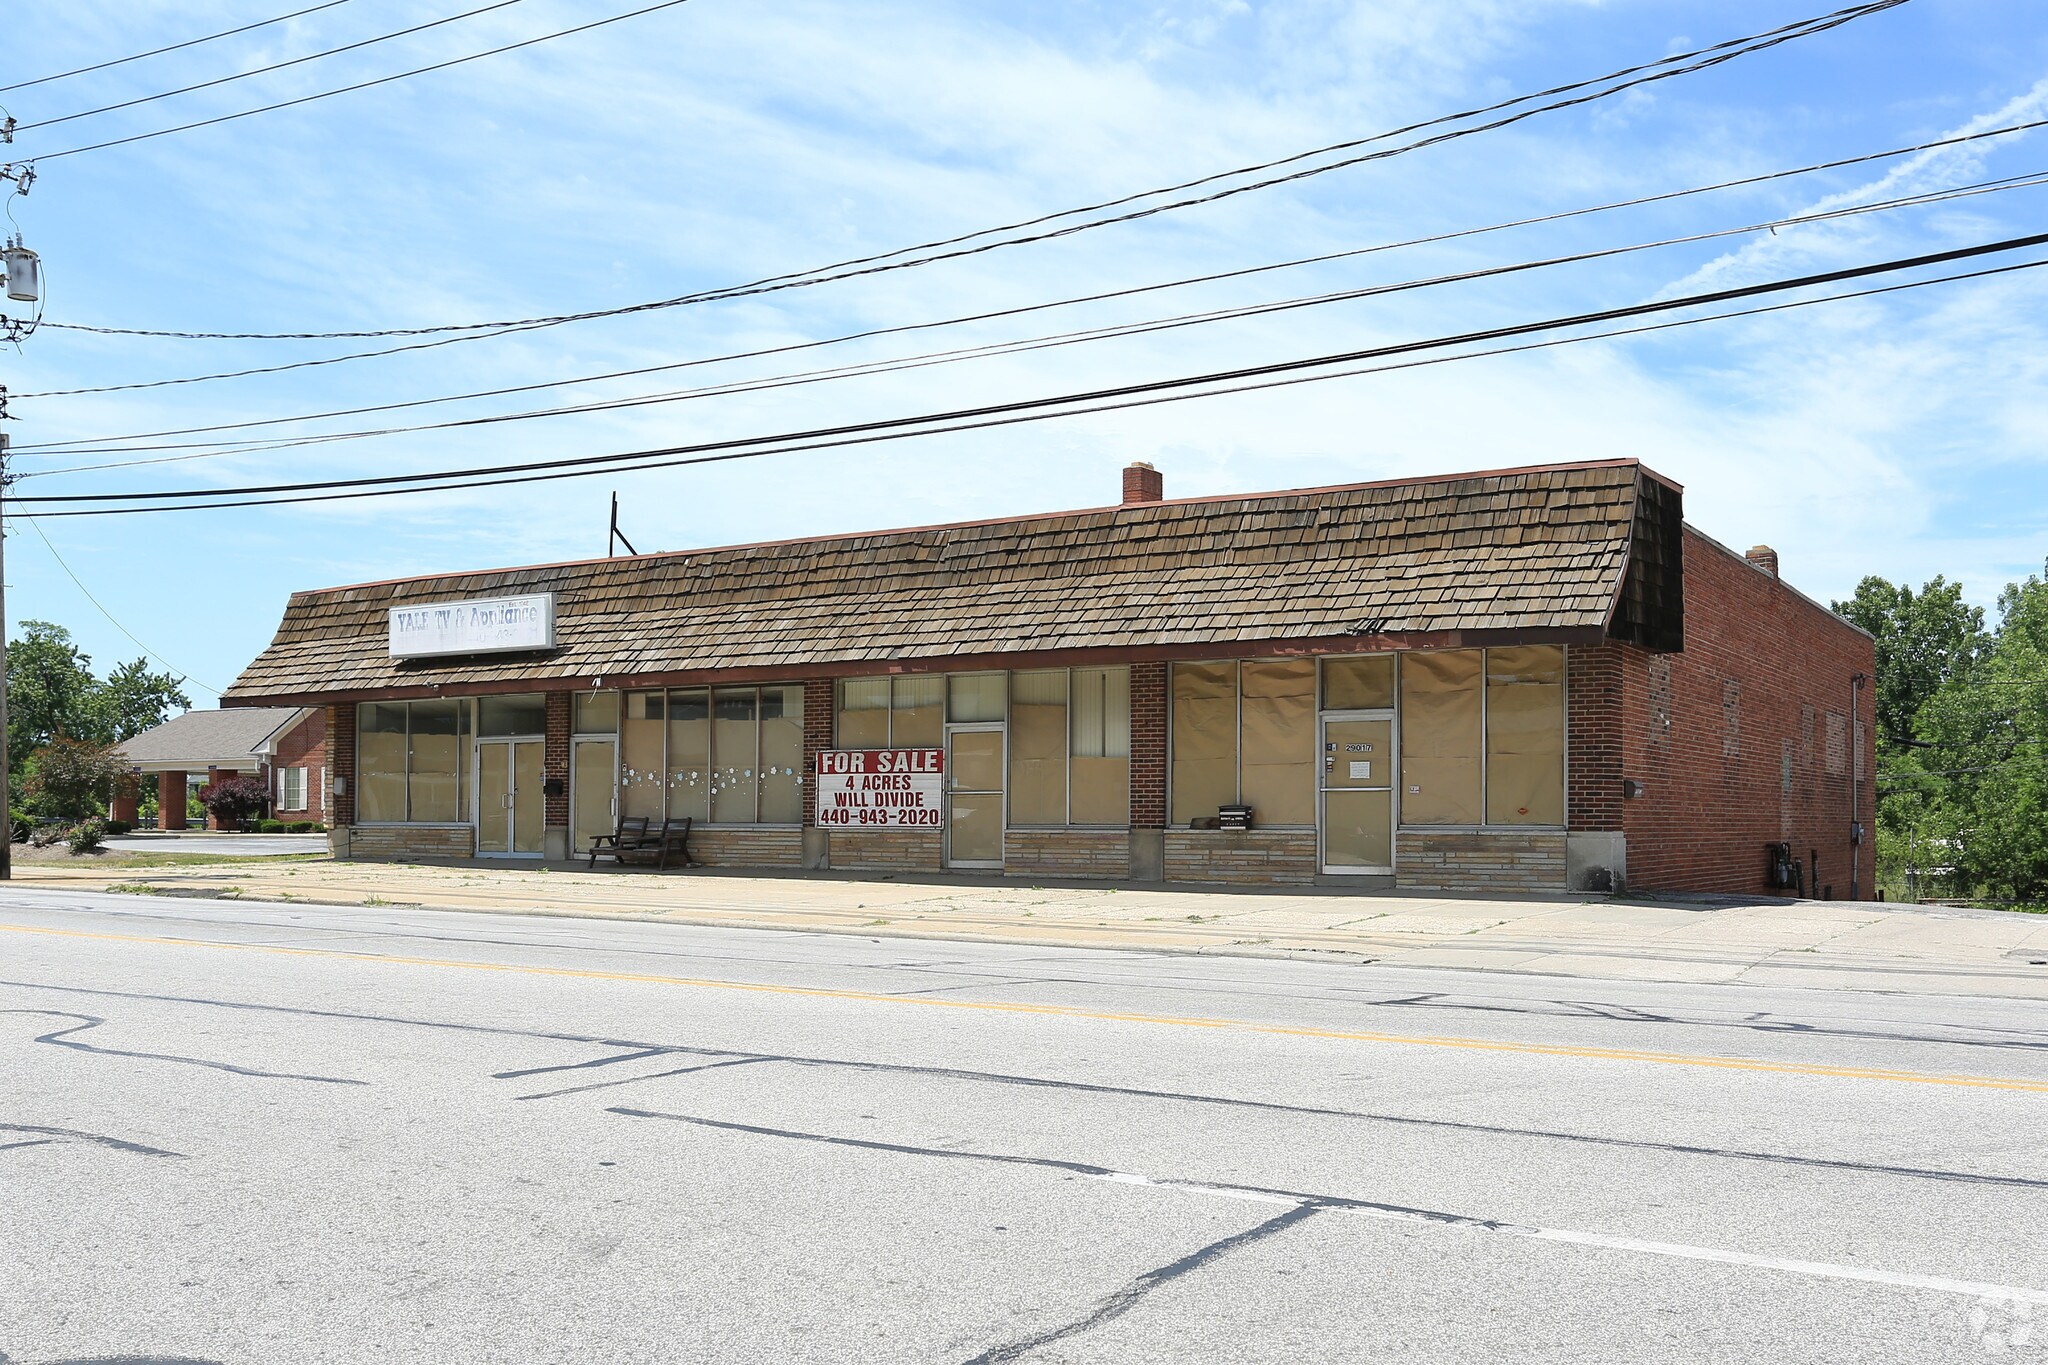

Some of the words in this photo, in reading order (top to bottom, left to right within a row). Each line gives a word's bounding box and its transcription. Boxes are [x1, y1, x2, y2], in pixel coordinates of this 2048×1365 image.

[397, 611, 429, 632] YALE
[435, 609, 451, 630] TV
[470, 604, 538, 629] Appliance
[1345, 743, 1372, 752] 29017
[822, 752, 865, 773] FOR
[877, 751, 938, 773] SALE
[845, 775, 855, 790] 4
[862, 774, 912, 790] ACRES
[834, 792, 869, 807] WILL
[874, 792, 924, 807] DIVIDE
[821, 809, 939, 825] 440-943-2020
